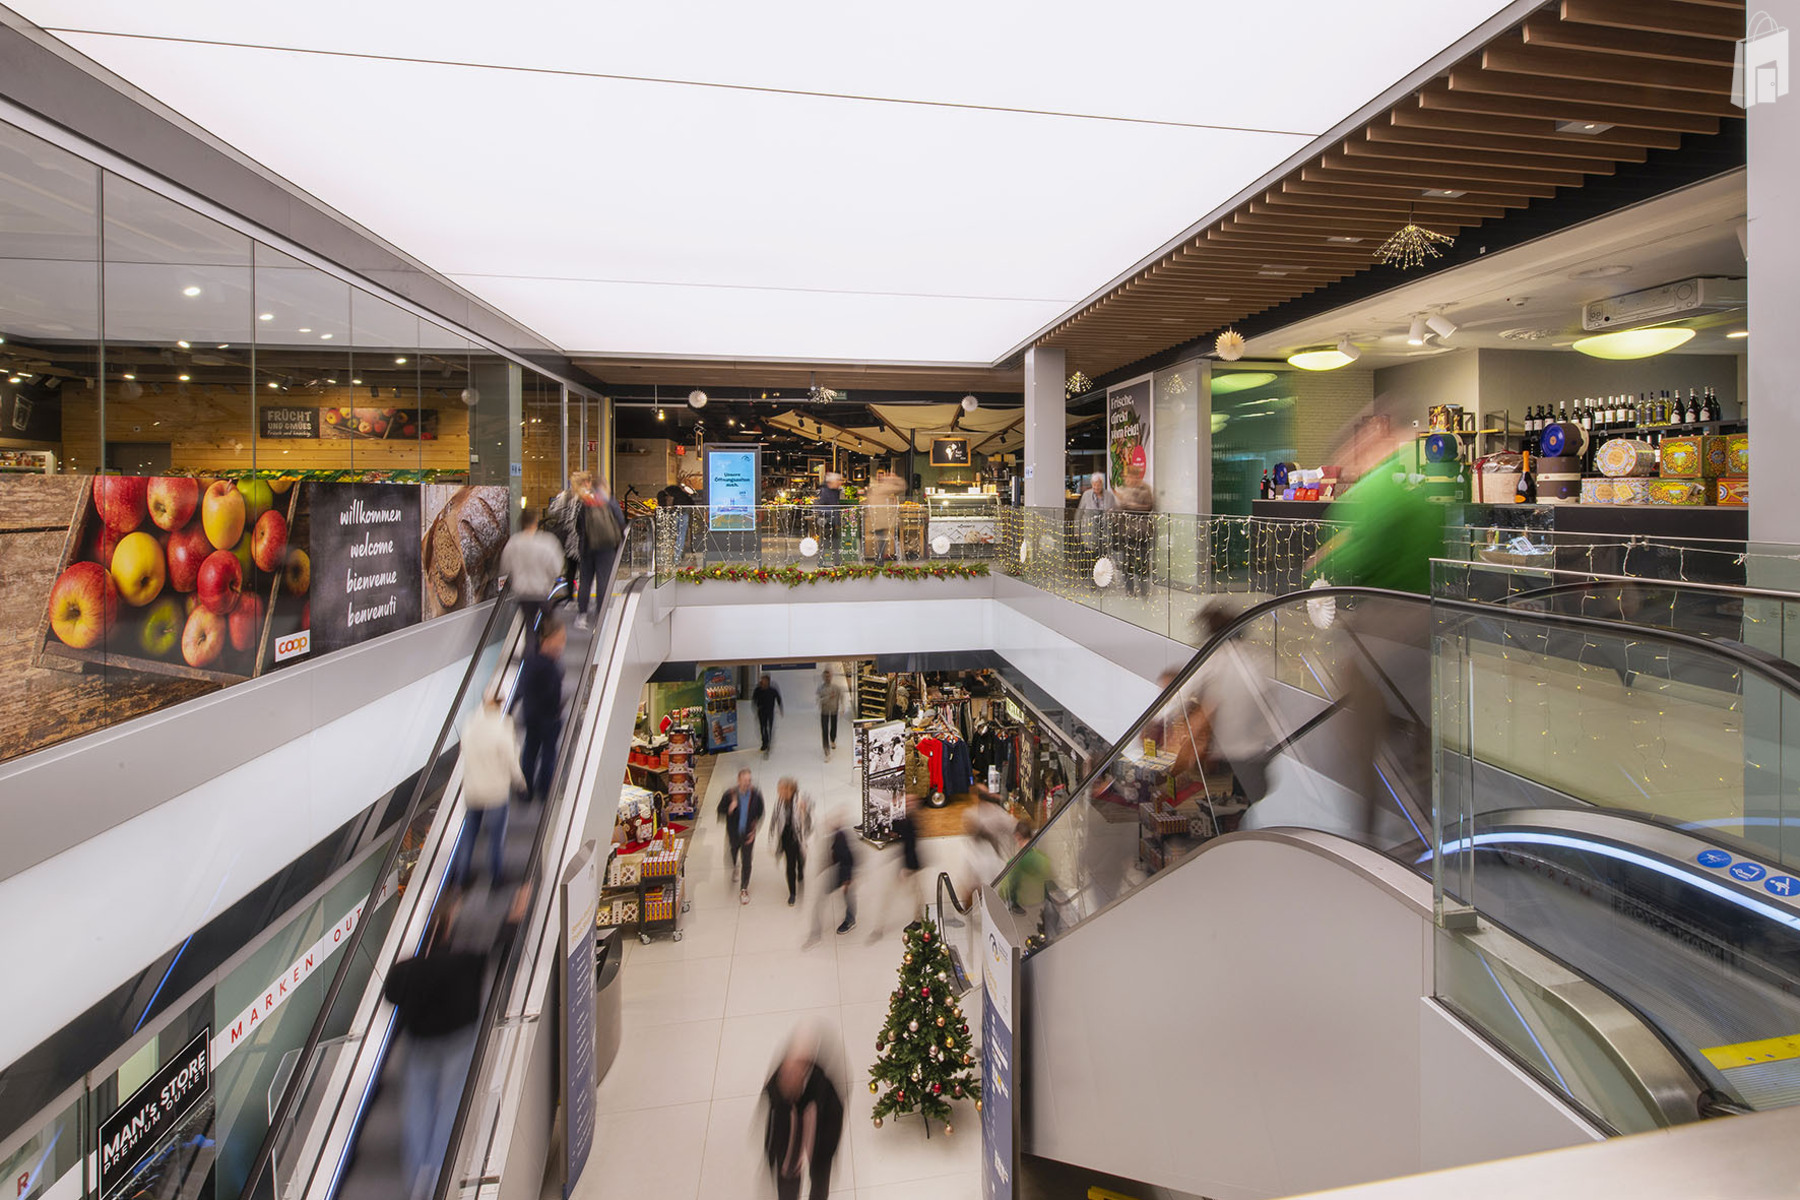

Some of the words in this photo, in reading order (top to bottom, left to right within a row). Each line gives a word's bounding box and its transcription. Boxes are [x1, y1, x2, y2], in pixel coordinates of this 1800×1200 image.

[1111, 395, 1134, 409] Frische,
[267, 409, 312, 421] FRÜCHT
[267, 422, 283, 430] UND
[1111, 411, 1128, 424] direkt
[340, 499, 401, 525] willkommen
[350, 531, 393, 558] welcome
[346, 568, 397, 593] bienvenue
[347, 595, 397, 627] benvenuti
[278, 636, 307, 654] coop
[231, 953, 314, 1044] MARKEN
[103, 1103, 157, 1164] MAN's
[160, 1050, 206, 1107] STORE
[103, 1113, 161, 1175] PREMIUM
[166, 1068, 206, 1111] OUTLET
